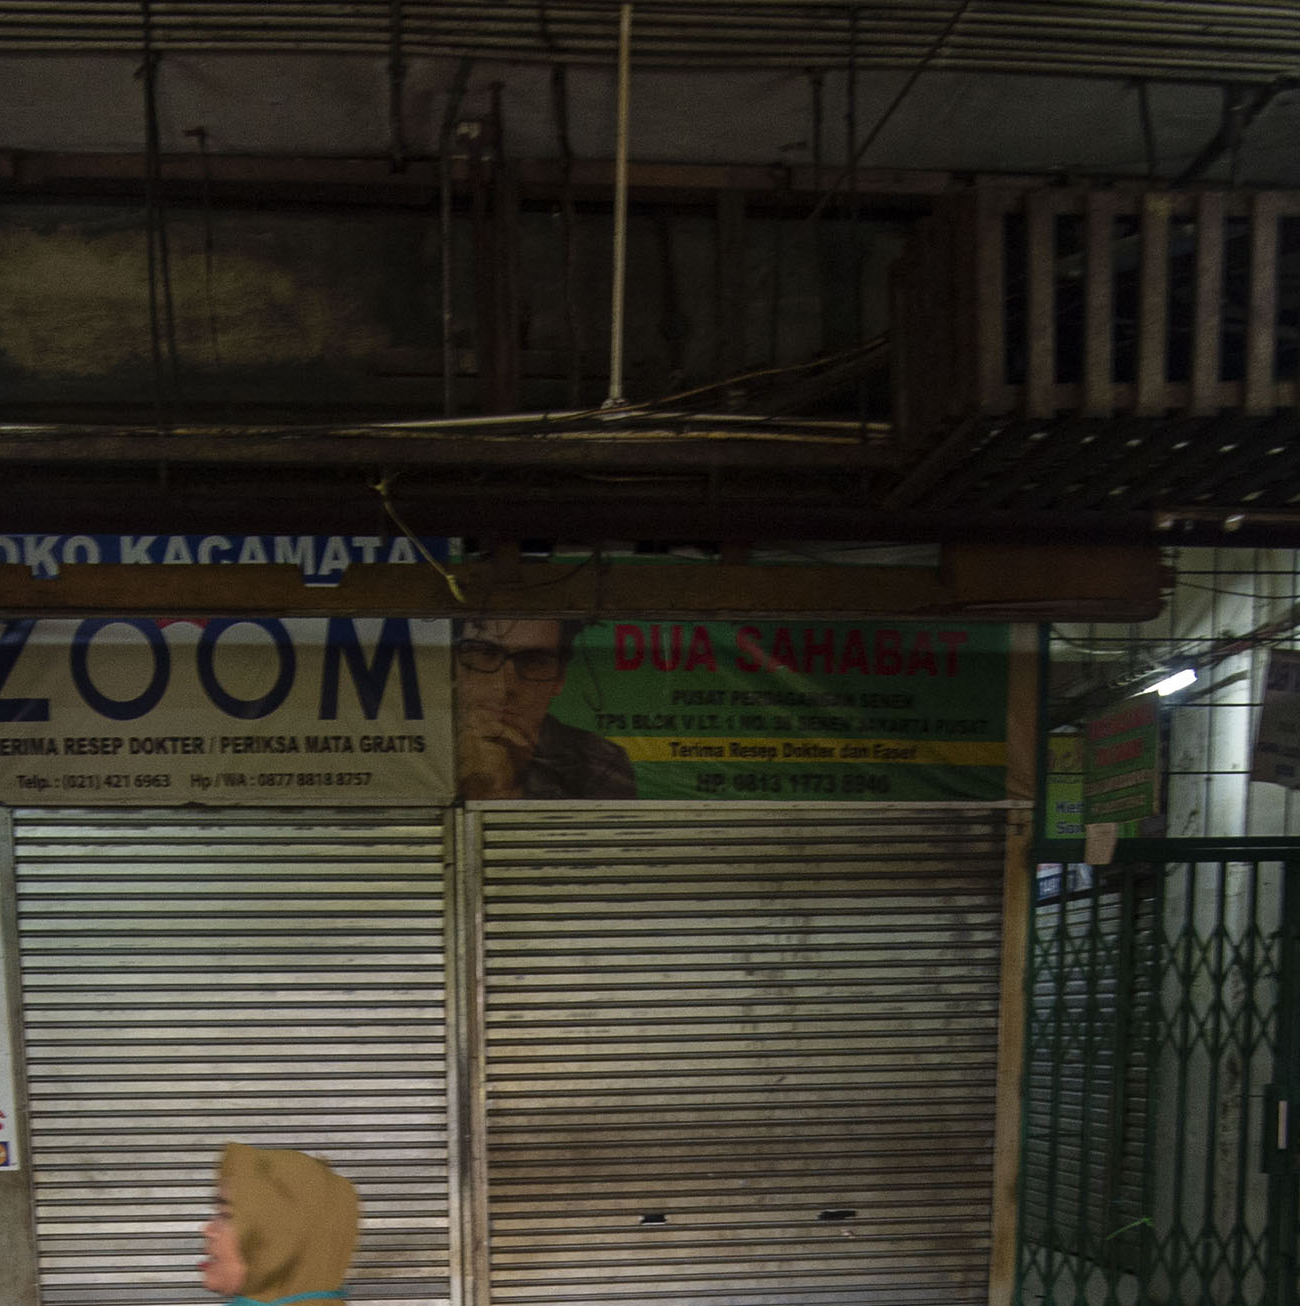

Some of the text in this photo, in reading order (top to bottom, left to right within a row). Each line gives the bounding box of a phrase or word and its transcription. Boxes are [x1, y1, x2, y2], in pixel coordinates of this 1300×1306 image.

[120, 534, 419, 576] KACAMATA
[614, 624, 969, 677] DUA SAHABAT
[64, 737, 124, 756] RESEP
[129, 737, 204, 755] DOKTER
[220, 735, 299, 754] PERIKSA
[305, 735, 354, 753] MATA
[359, 734, 426, 754] GRATIS
[670, 742, 724, 758] Terima
[729, 742, 778, 762] Resep
[782, 743, 835, 758] Dokter
[839, 744, 867, 759] dan
[63, 774, 101, 791] (021)
[104, 774, 131, 788] 421
[134, 774, 172, 788] 6963
[190, 774, 212, 791] Hp
[258, 773, 294, 787] 0877
